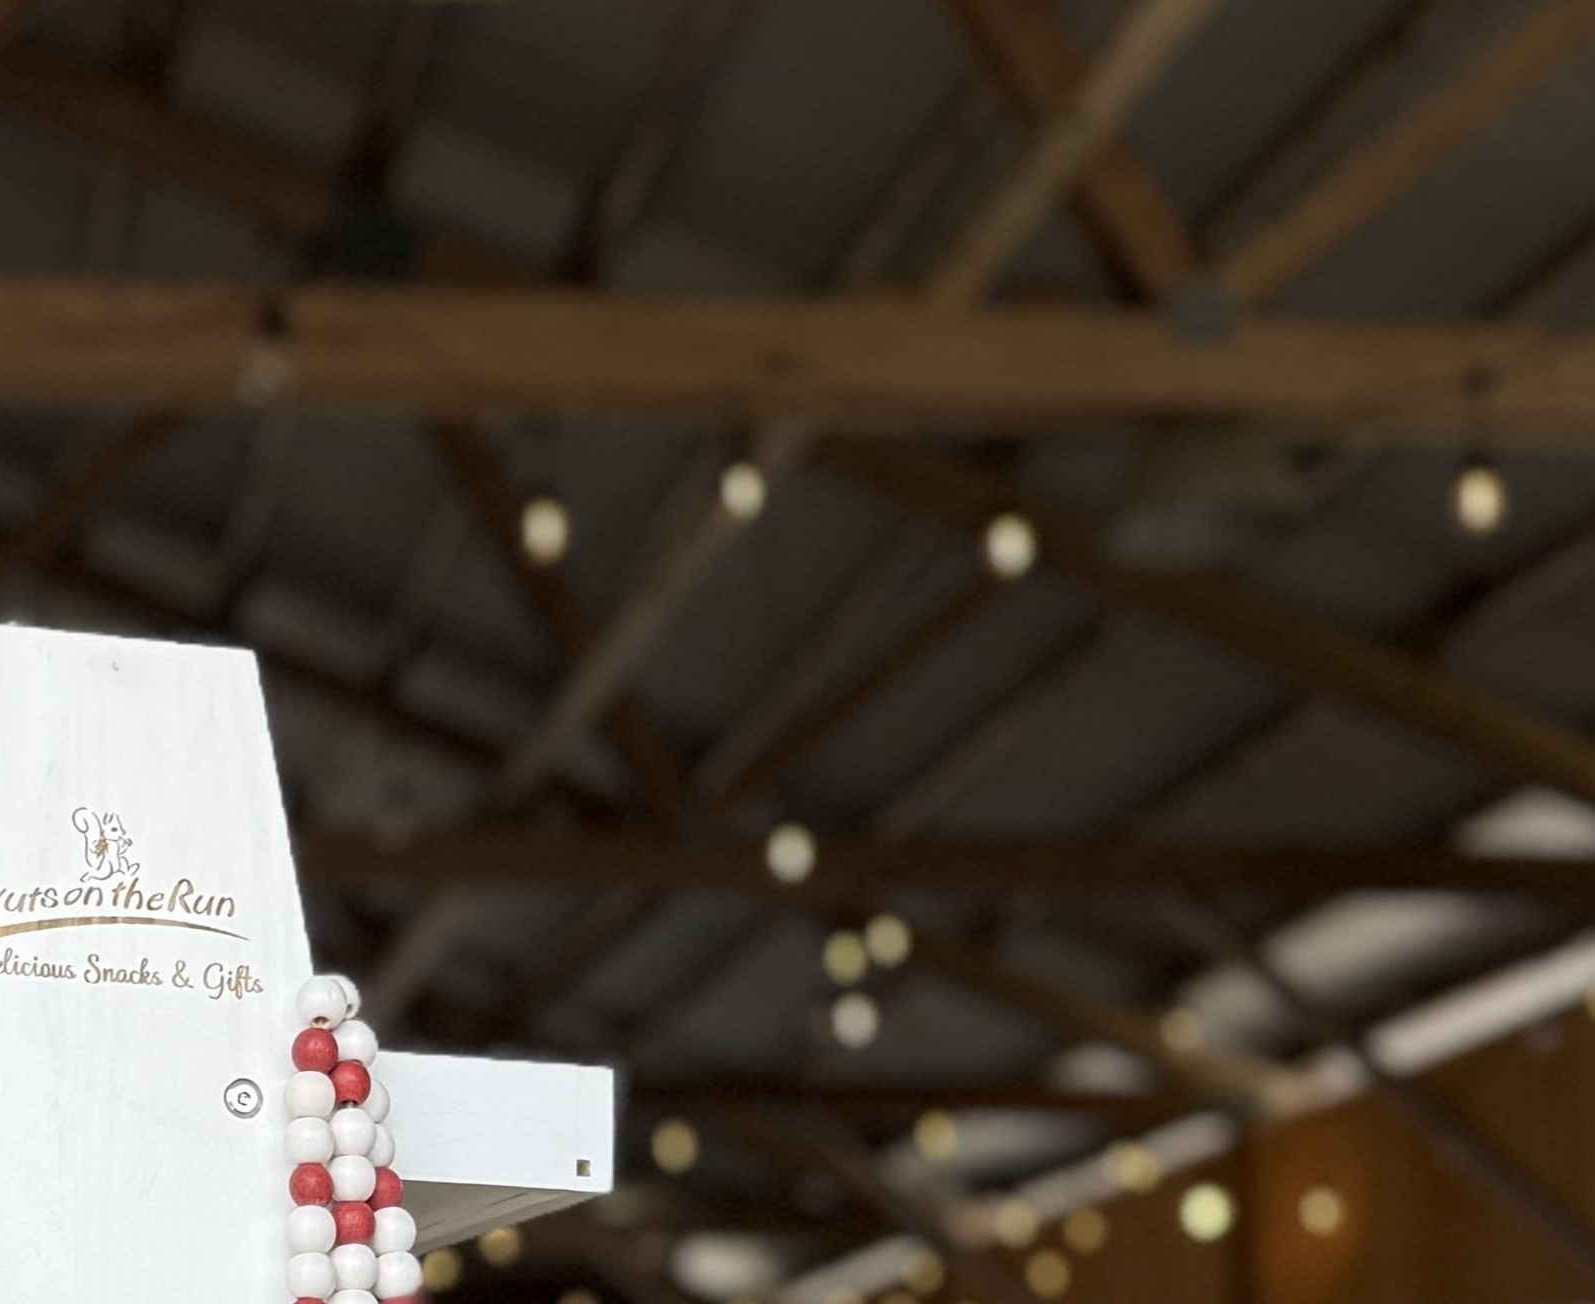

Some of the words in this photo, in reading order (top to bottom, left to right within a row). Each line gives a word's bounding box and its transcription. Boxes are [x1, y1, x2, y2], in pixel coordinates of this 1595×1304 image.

[83, 953, 164, 986] Snacks
[171, 960, 194, 989] &
[203, 962, 264, 1000] Gifts
